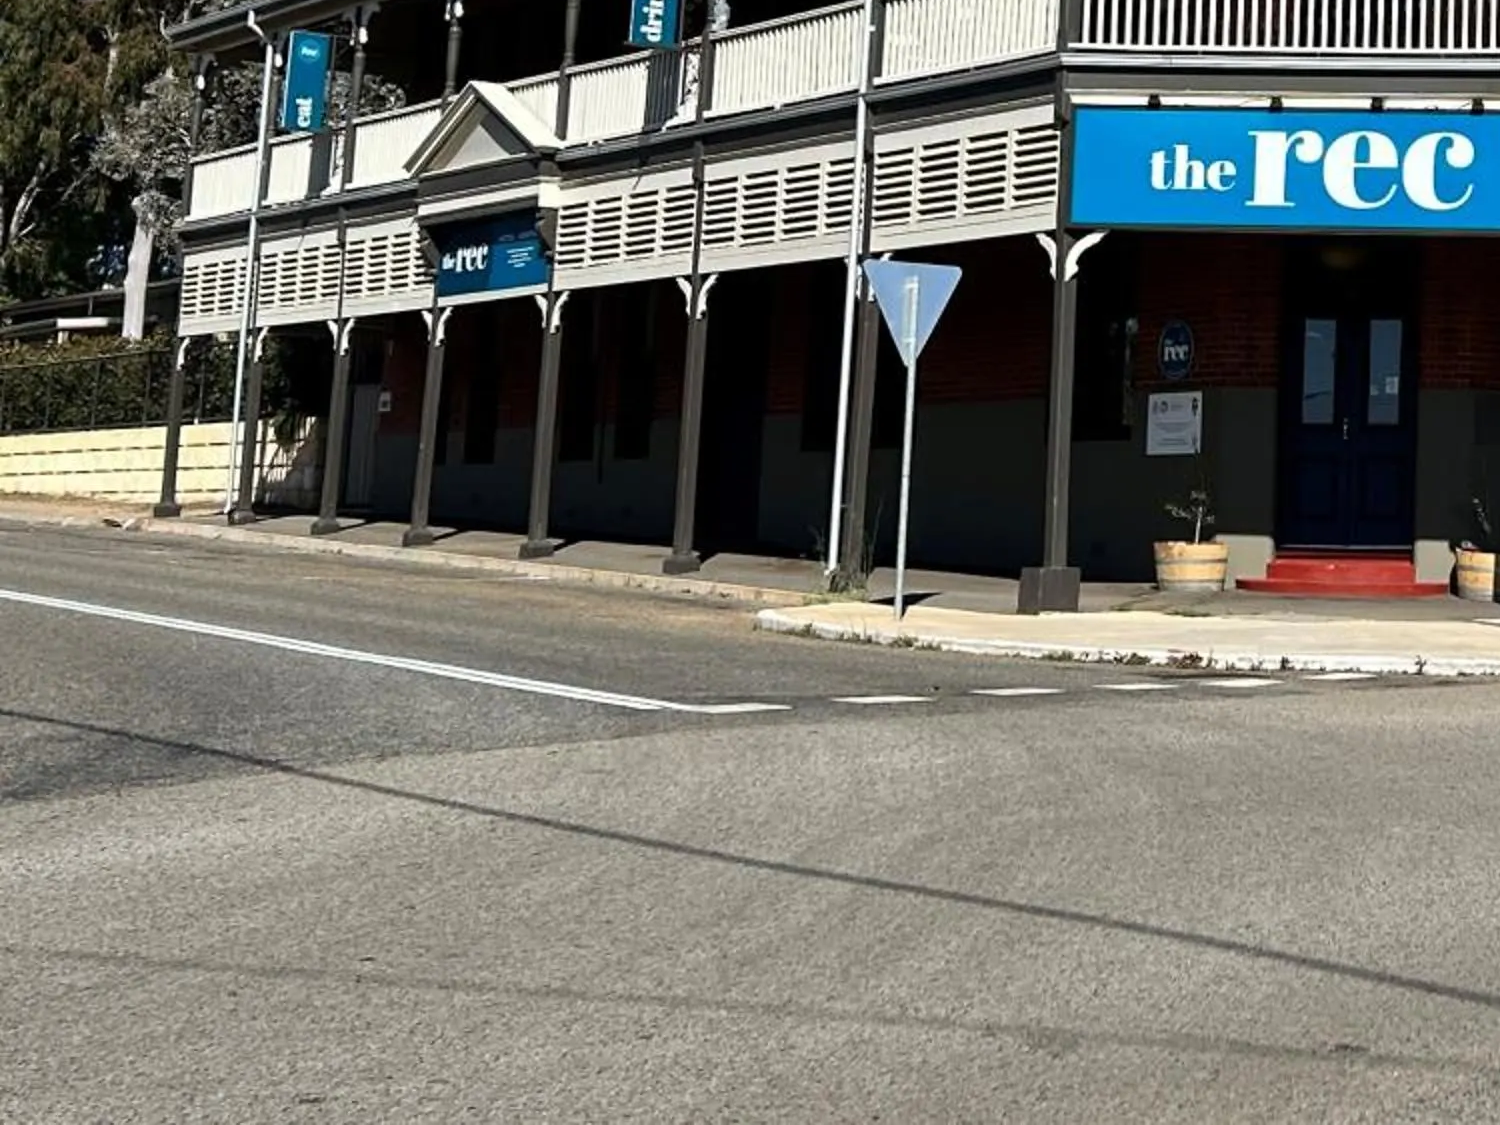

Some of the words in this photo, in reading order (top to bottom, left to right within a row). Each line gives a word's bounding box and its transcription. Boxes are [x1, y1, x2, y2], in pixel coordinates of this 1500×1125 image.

[1149, 144, 1237, 192] the
[1244, 128, 1476, 211] rec
[455, 243, 489, 272] rec
